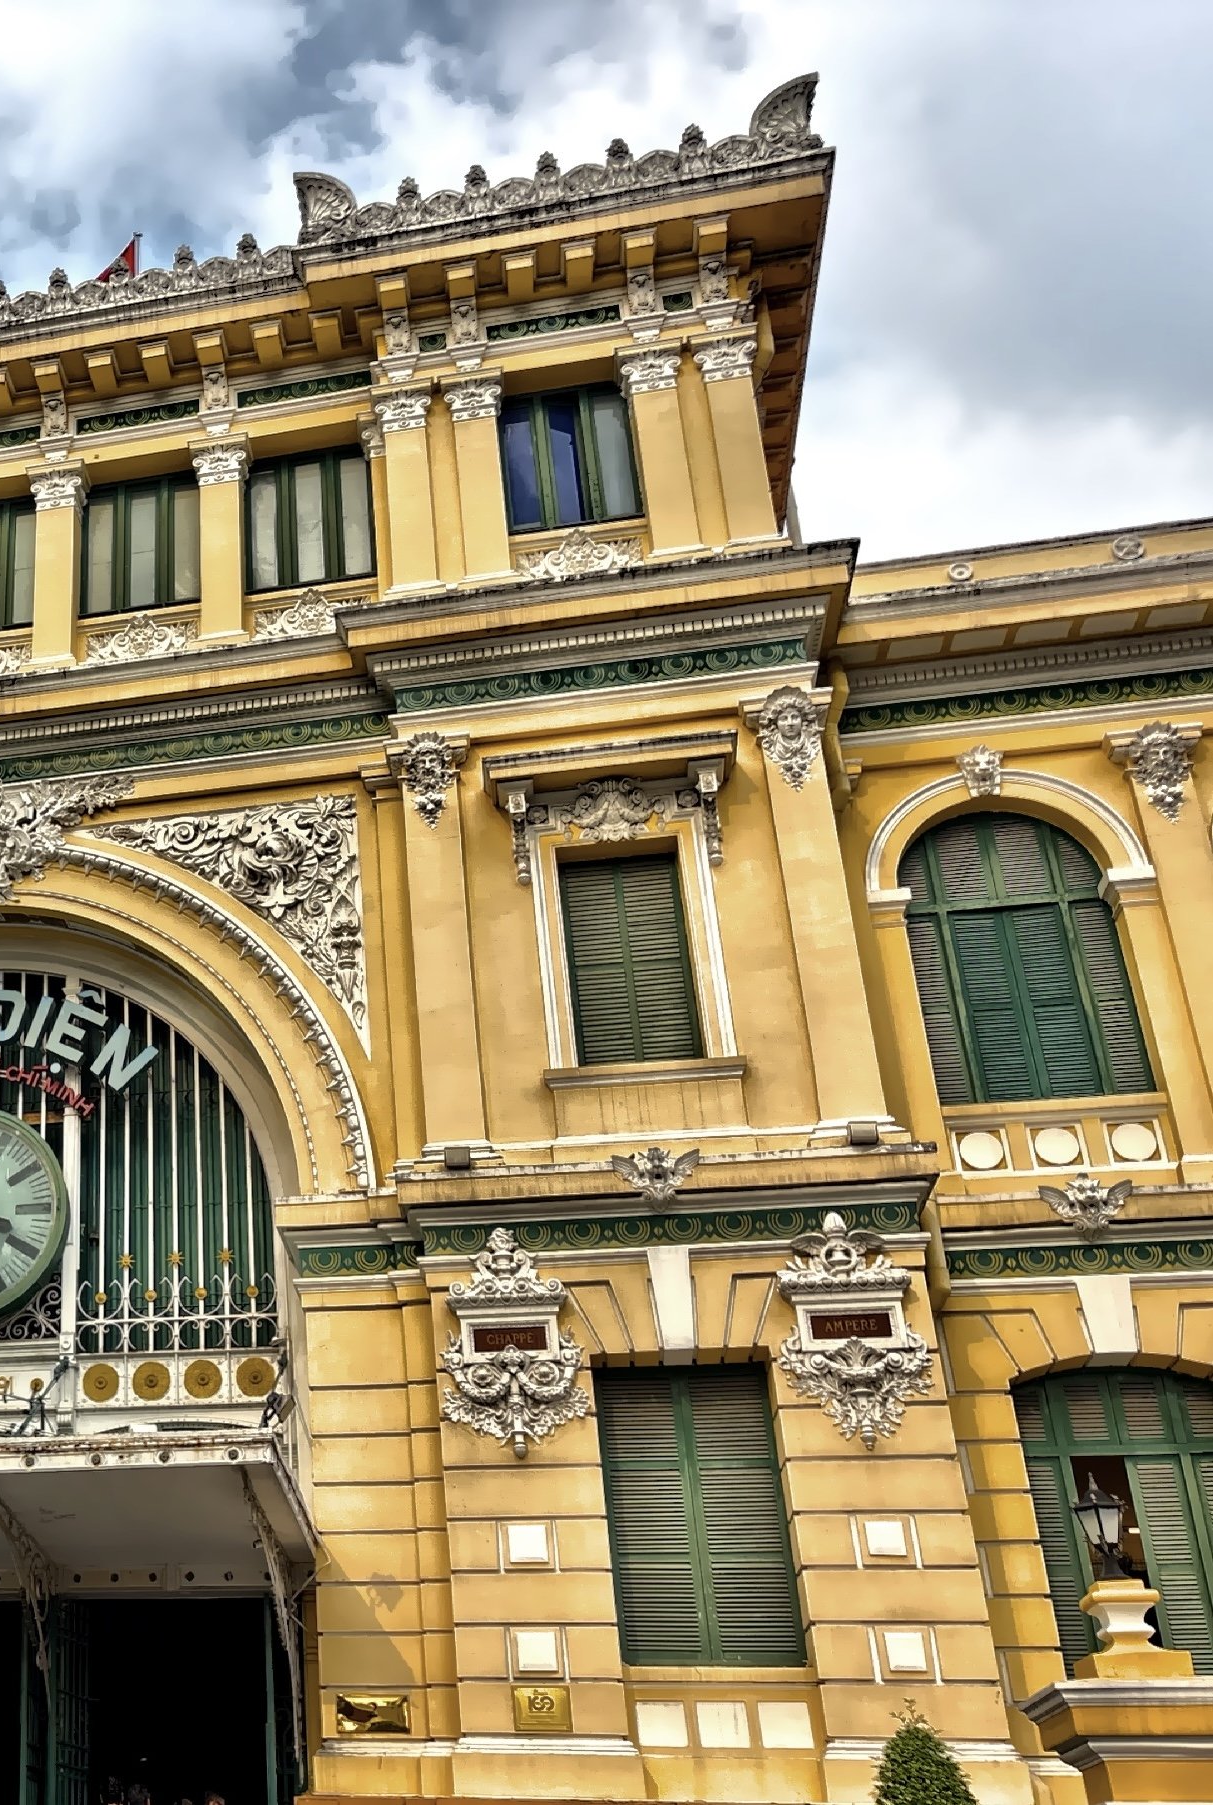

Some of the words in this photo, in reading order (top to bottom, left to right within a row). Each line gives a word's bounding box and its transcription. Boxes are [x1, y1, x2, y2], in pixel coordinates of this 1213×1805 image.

[40, 1077, 96, 1117] MINH
[825, 1319, 878, 1333] AMPERE
[486, 1332, 534, 1345] CHAPPE
